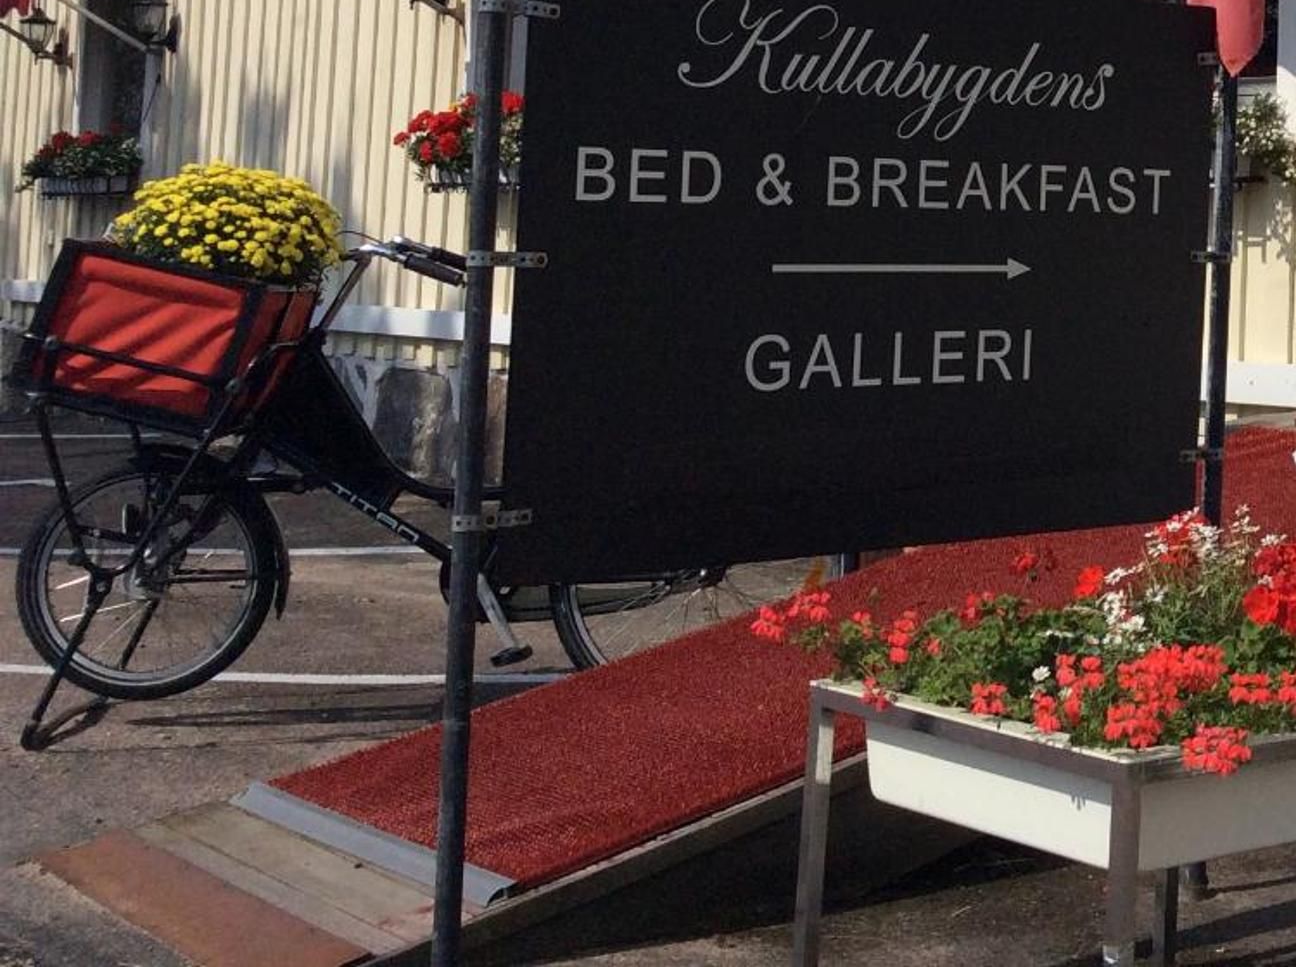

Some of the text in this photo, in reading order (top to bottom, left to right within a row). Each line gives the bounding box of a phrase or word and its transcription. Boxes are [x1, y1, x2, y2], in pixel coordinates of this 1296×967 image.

[574, 146, 1172, 215] BED & BREAKFAST
[744, 329, 1033, 392] GALLERI
